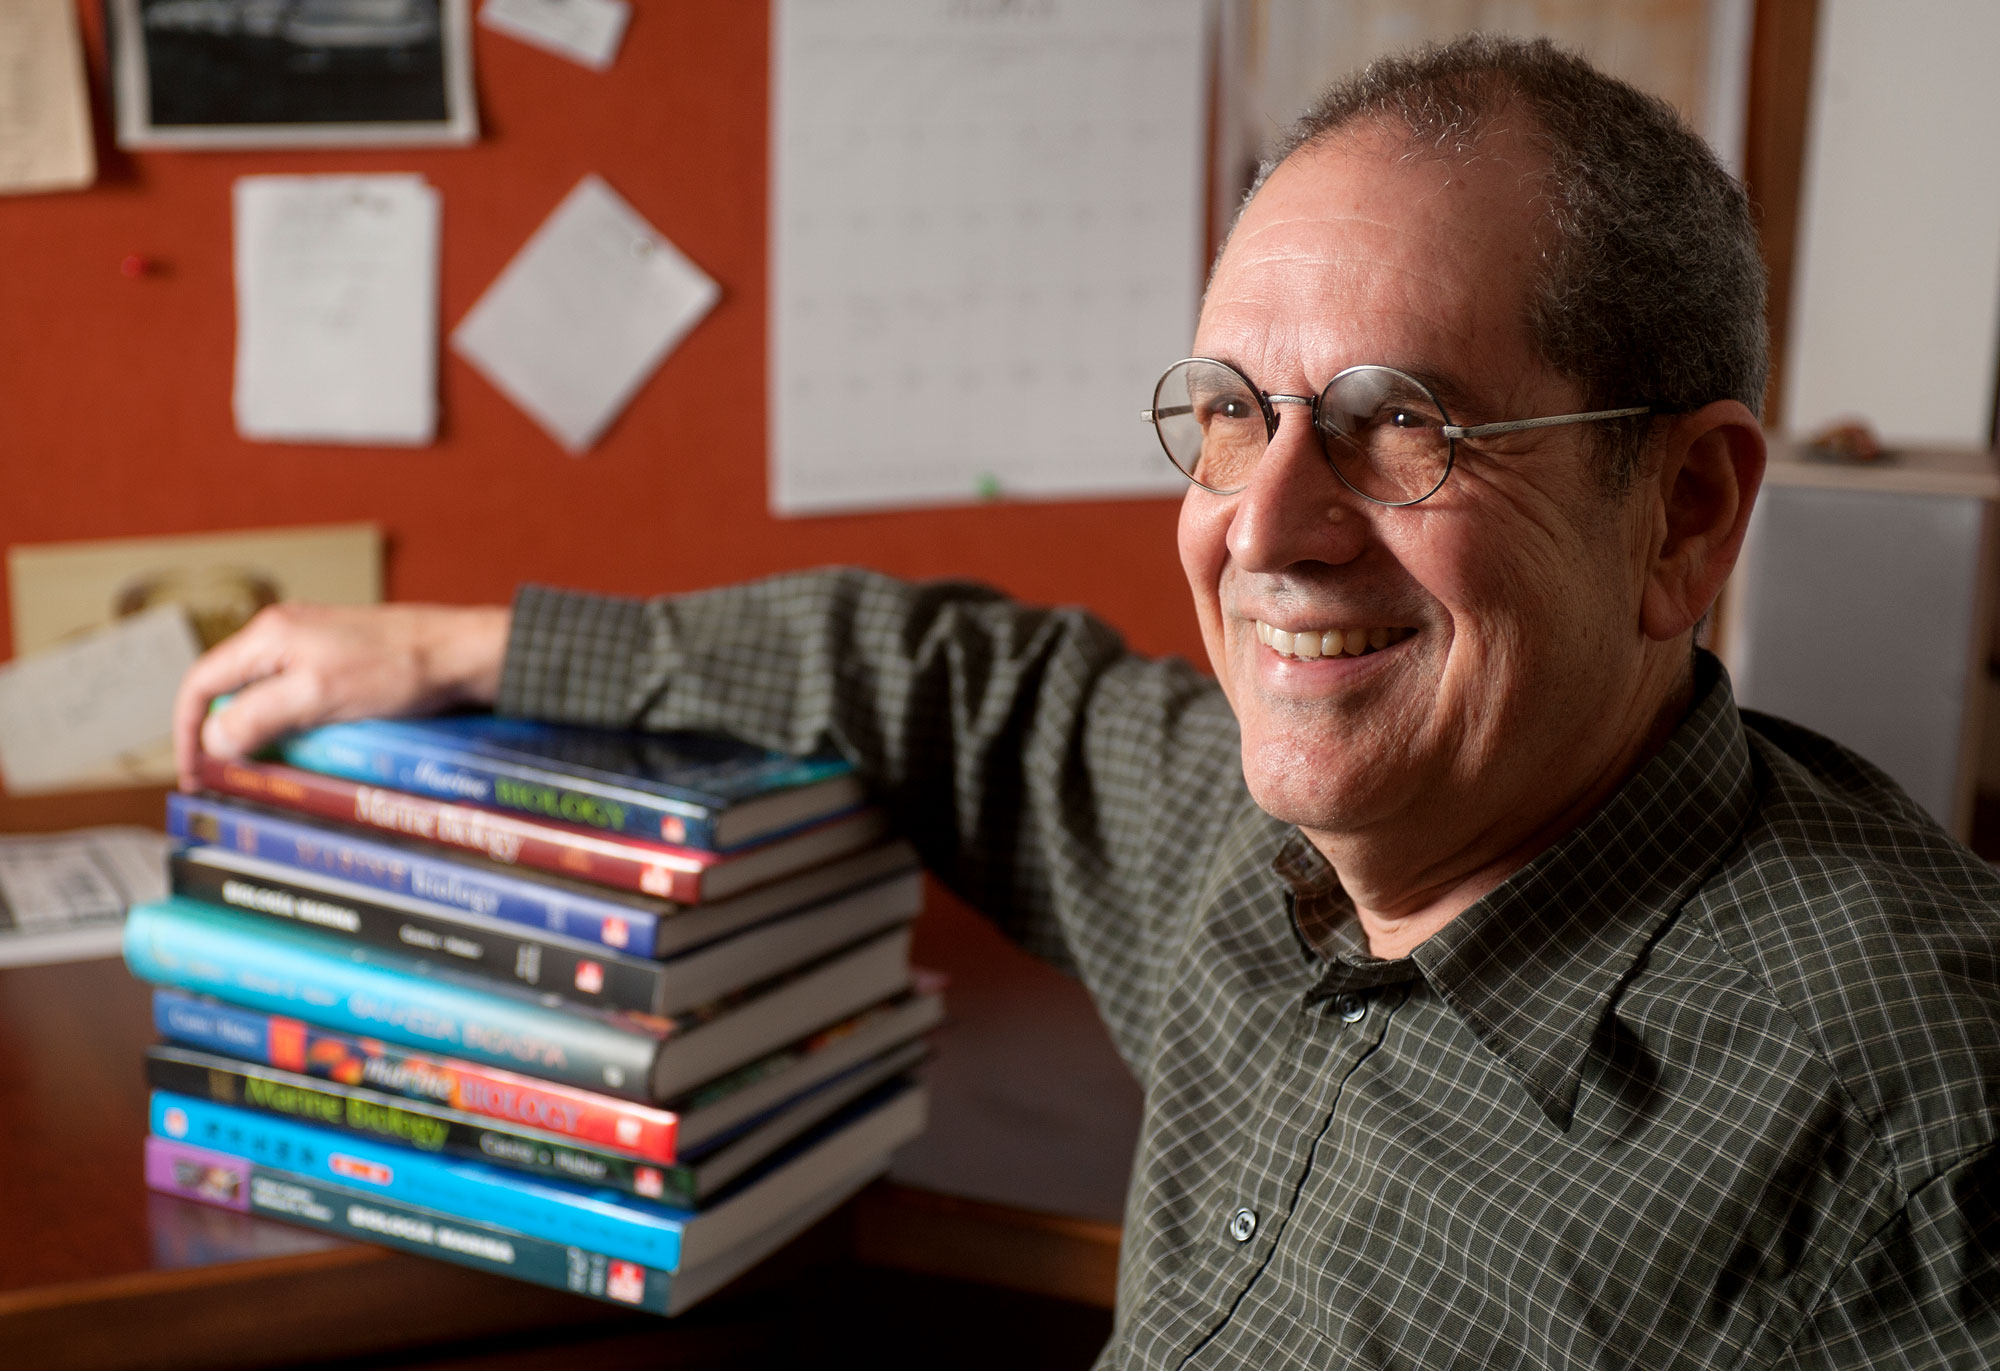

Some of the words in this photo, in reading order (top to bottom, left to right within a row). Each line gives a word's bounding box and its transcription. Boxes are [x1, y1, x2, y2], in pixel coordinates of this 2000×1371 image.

[355, 785, 437, 838] Marine
[402, 757, 492, 801] Marine
[496, 776, 627, 830] BIOLOGY
[245, 1074, 344, 1124] Marine
[346, 1096, 451, 1151] Biology
[459, 1077, 582, 1133] BIOLOGY
